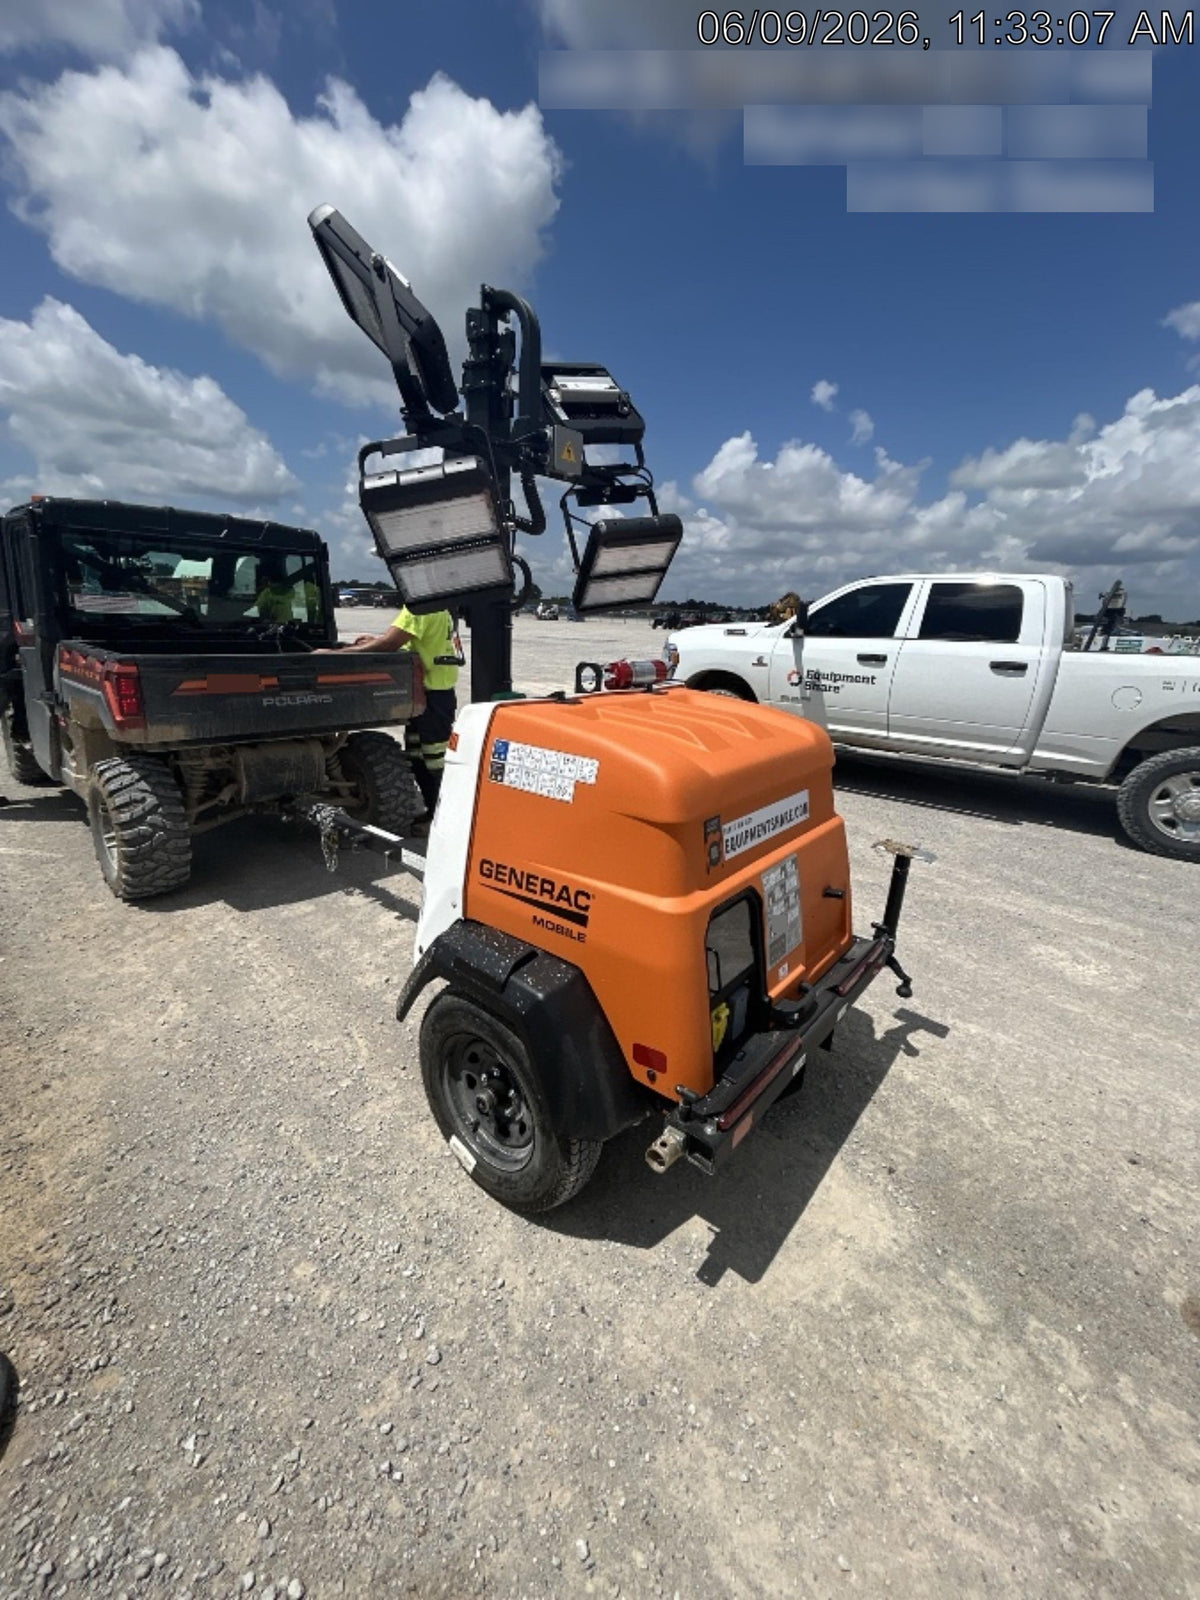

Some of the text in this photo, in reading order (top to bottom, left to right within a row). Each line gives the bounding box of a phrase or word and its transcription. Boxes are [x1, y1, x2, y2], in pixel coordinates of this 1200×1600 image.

[806, 669, 876, 685] Equipment
[262, 694, 333, 707] POLARIS
[479, 858, 591, 913] GENERAC
[532, 914, 587, 943] MOBILE
